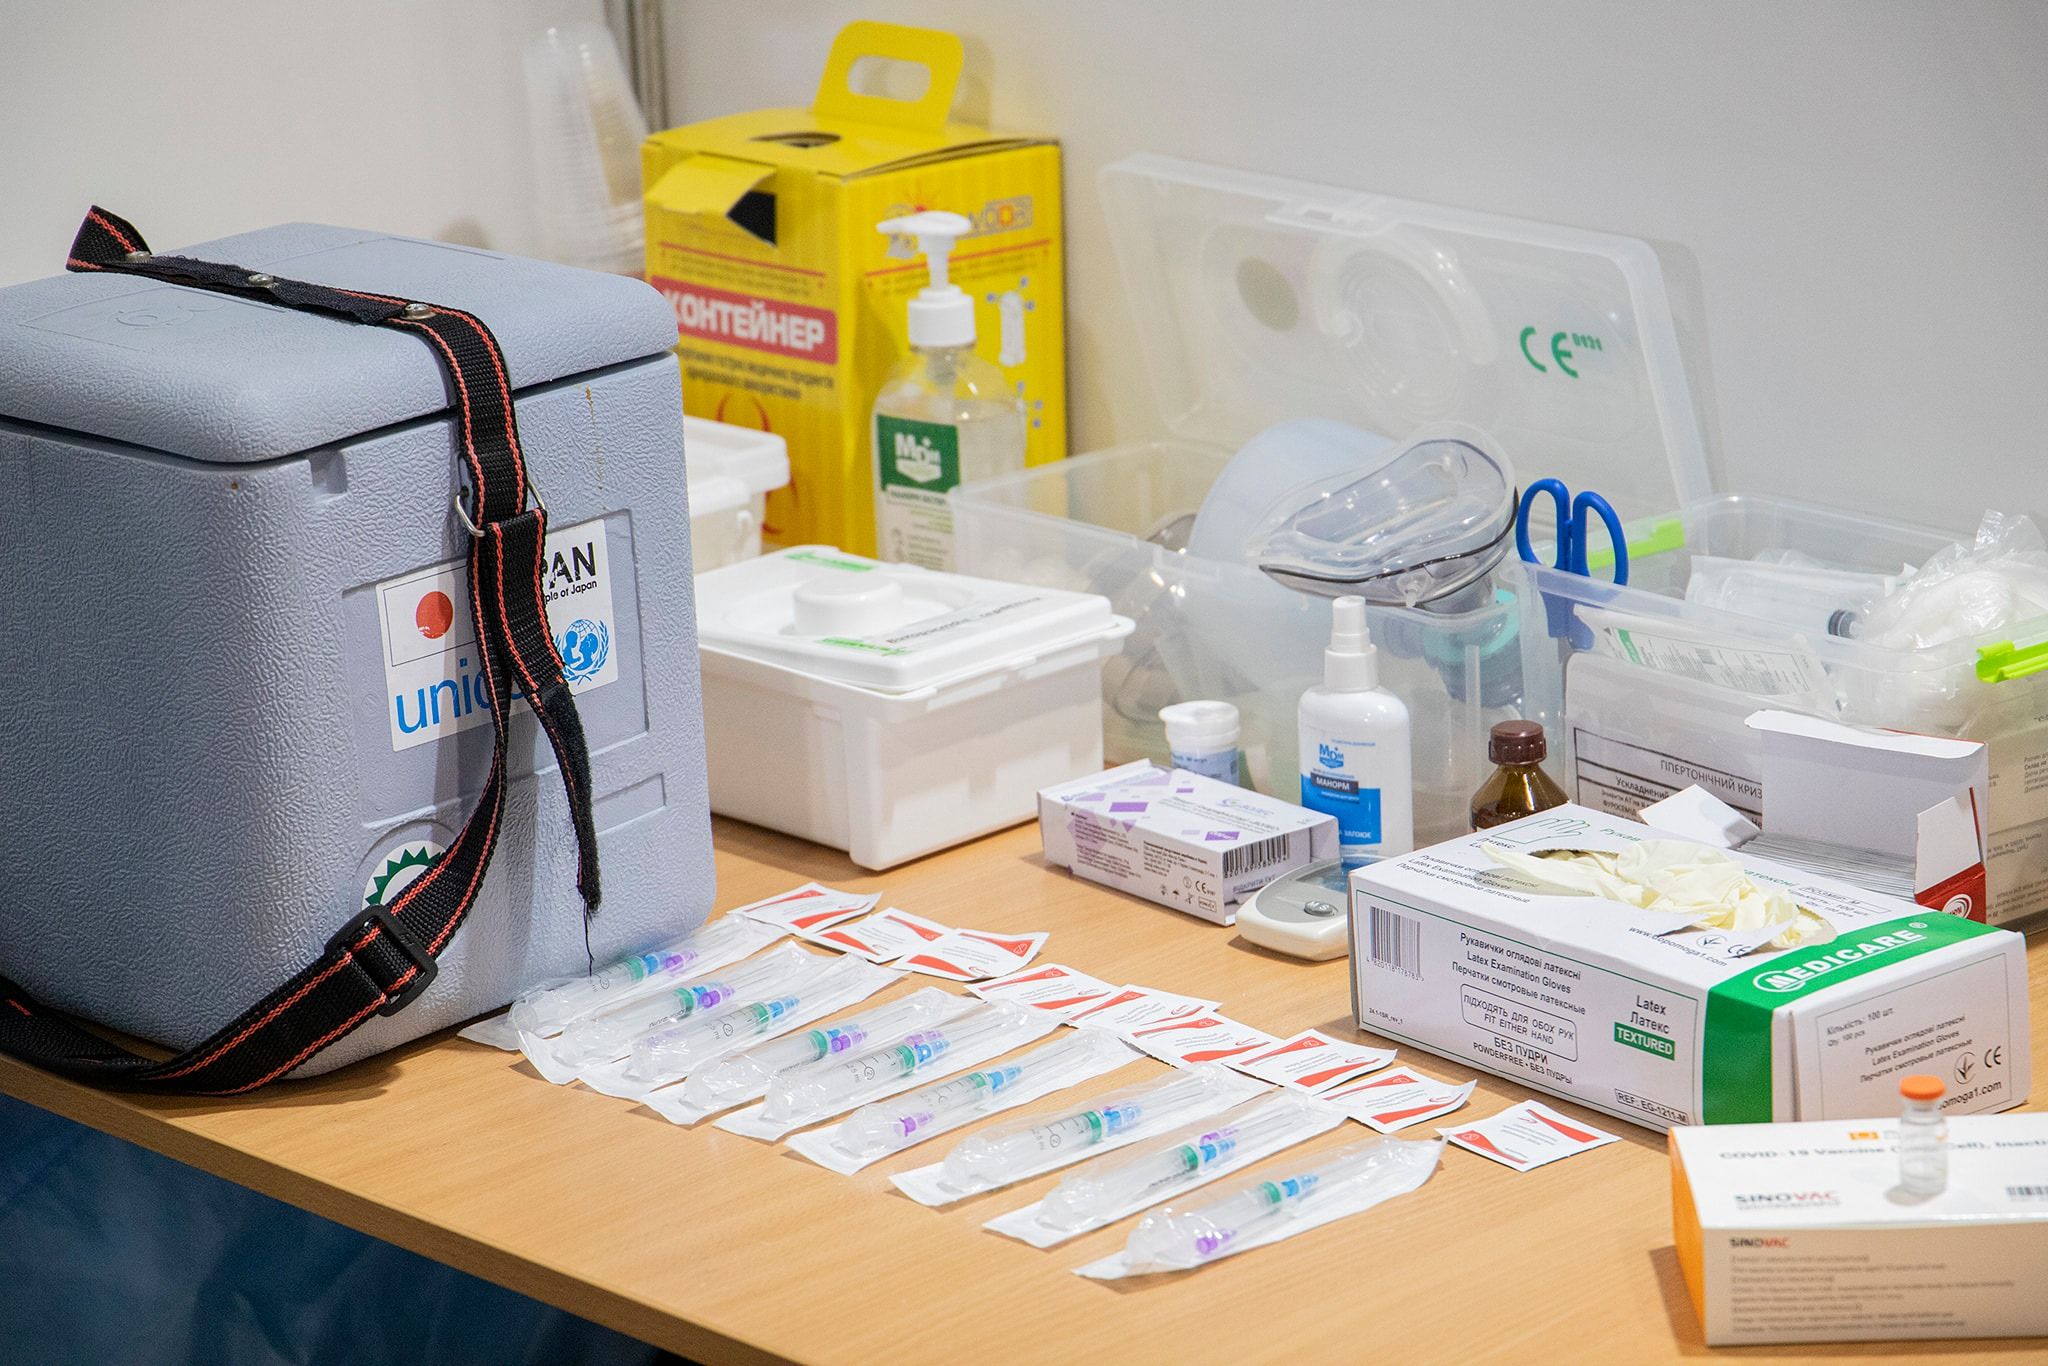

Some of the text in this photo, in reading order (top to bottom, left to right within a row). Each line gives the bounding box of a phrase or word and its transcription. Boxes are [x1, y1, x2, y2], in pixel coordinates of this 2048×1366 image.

[664, 289, 827, 352] КОНТЕЙНЕР
[570, 580, 598, 595] Japan
[1316, 777, 1350, 792] МАНОРМ
[1660, 759, 1763, 799] ГІПЕРТОНІЧНИЙ КРИЗ
[1397, 862, 1435, 879] Перчатки
[1408, 858, 1431, 871] Latex
[1431, 863, 1482, 884] Examination
[1460, 932, 1582, 981] Рукавички оглядові латексні
[1764, 929, 1918, 990] MEDICARE
[1467, 950, 1572, 994] Latex Examination Gloves
[1452, 961, 1586, 1015] Перчатки смотровые латексные
[1463, 994, 1575, 1041] ПІДХОДЯТЬ ДЛЯ ОБОХ РУК
[1636, 995, 1666, 1016] Latex
[1484, 1013, 1555, 1045] FIT EITHER HAND
[1630, 1011, 1671, 1035] Латекс
[1494, 1037, 1549, 1065] БЕЗ ПУДРИ
[1616, 1026, 1673, 1056] TEXTURED
[1872, 1030, 1961, 1066] Latex Examination Gloves
[1473, 1042, 1525, 1068] POWDERFREE
[1529, 1062, 1545, 1075] БЕЗ
[1641, 1100, 1687, 1122] EG-1211-M
[1719, 1150, 1809, 1160] COVID-19
[1813, 1146, 1886, 1157] Vaccine
[1734, 1190, 1842, 1204] SINOVAC
[1728, 1237, 1791, 1249] SINOVAC
